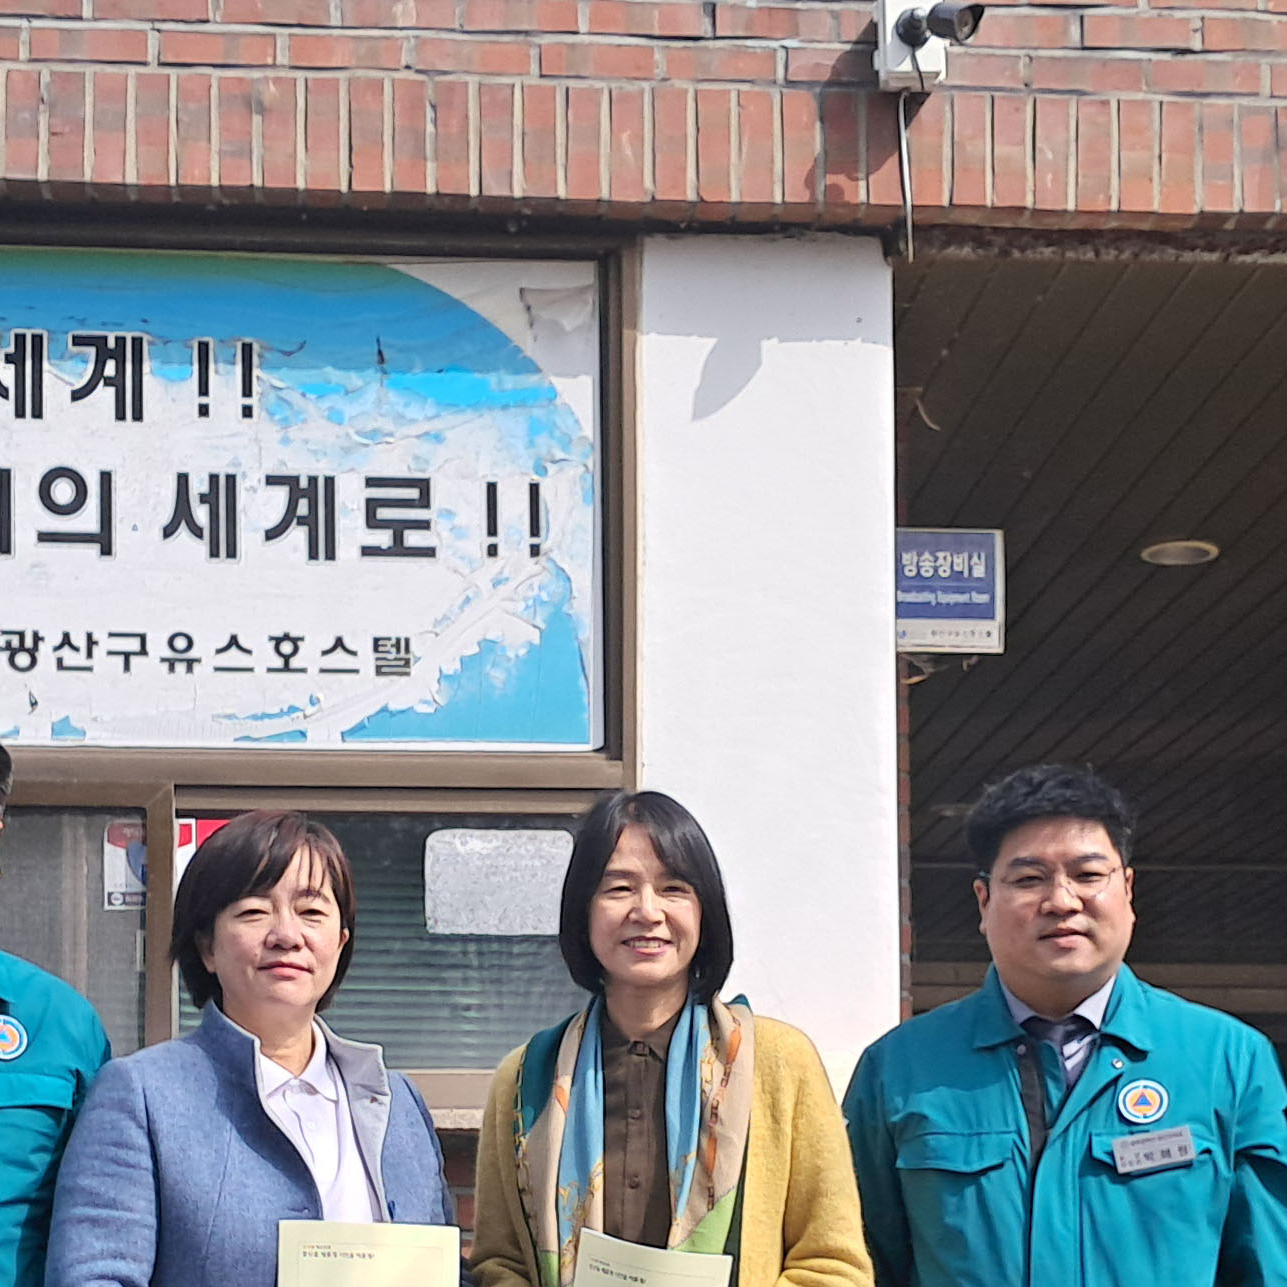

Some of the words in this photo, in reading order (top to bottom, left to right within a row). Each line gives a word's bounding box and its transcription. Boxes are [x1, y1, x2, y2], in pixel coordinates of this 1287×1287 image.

[196, 340, 254, 418] !!
[161, 472, 437, 562] 세계로
[485, 482, 541, 559] !!
[901, 551, 986, 578] 방송장비실
[0, 629, 413, 676] 광산구유스호스텔
